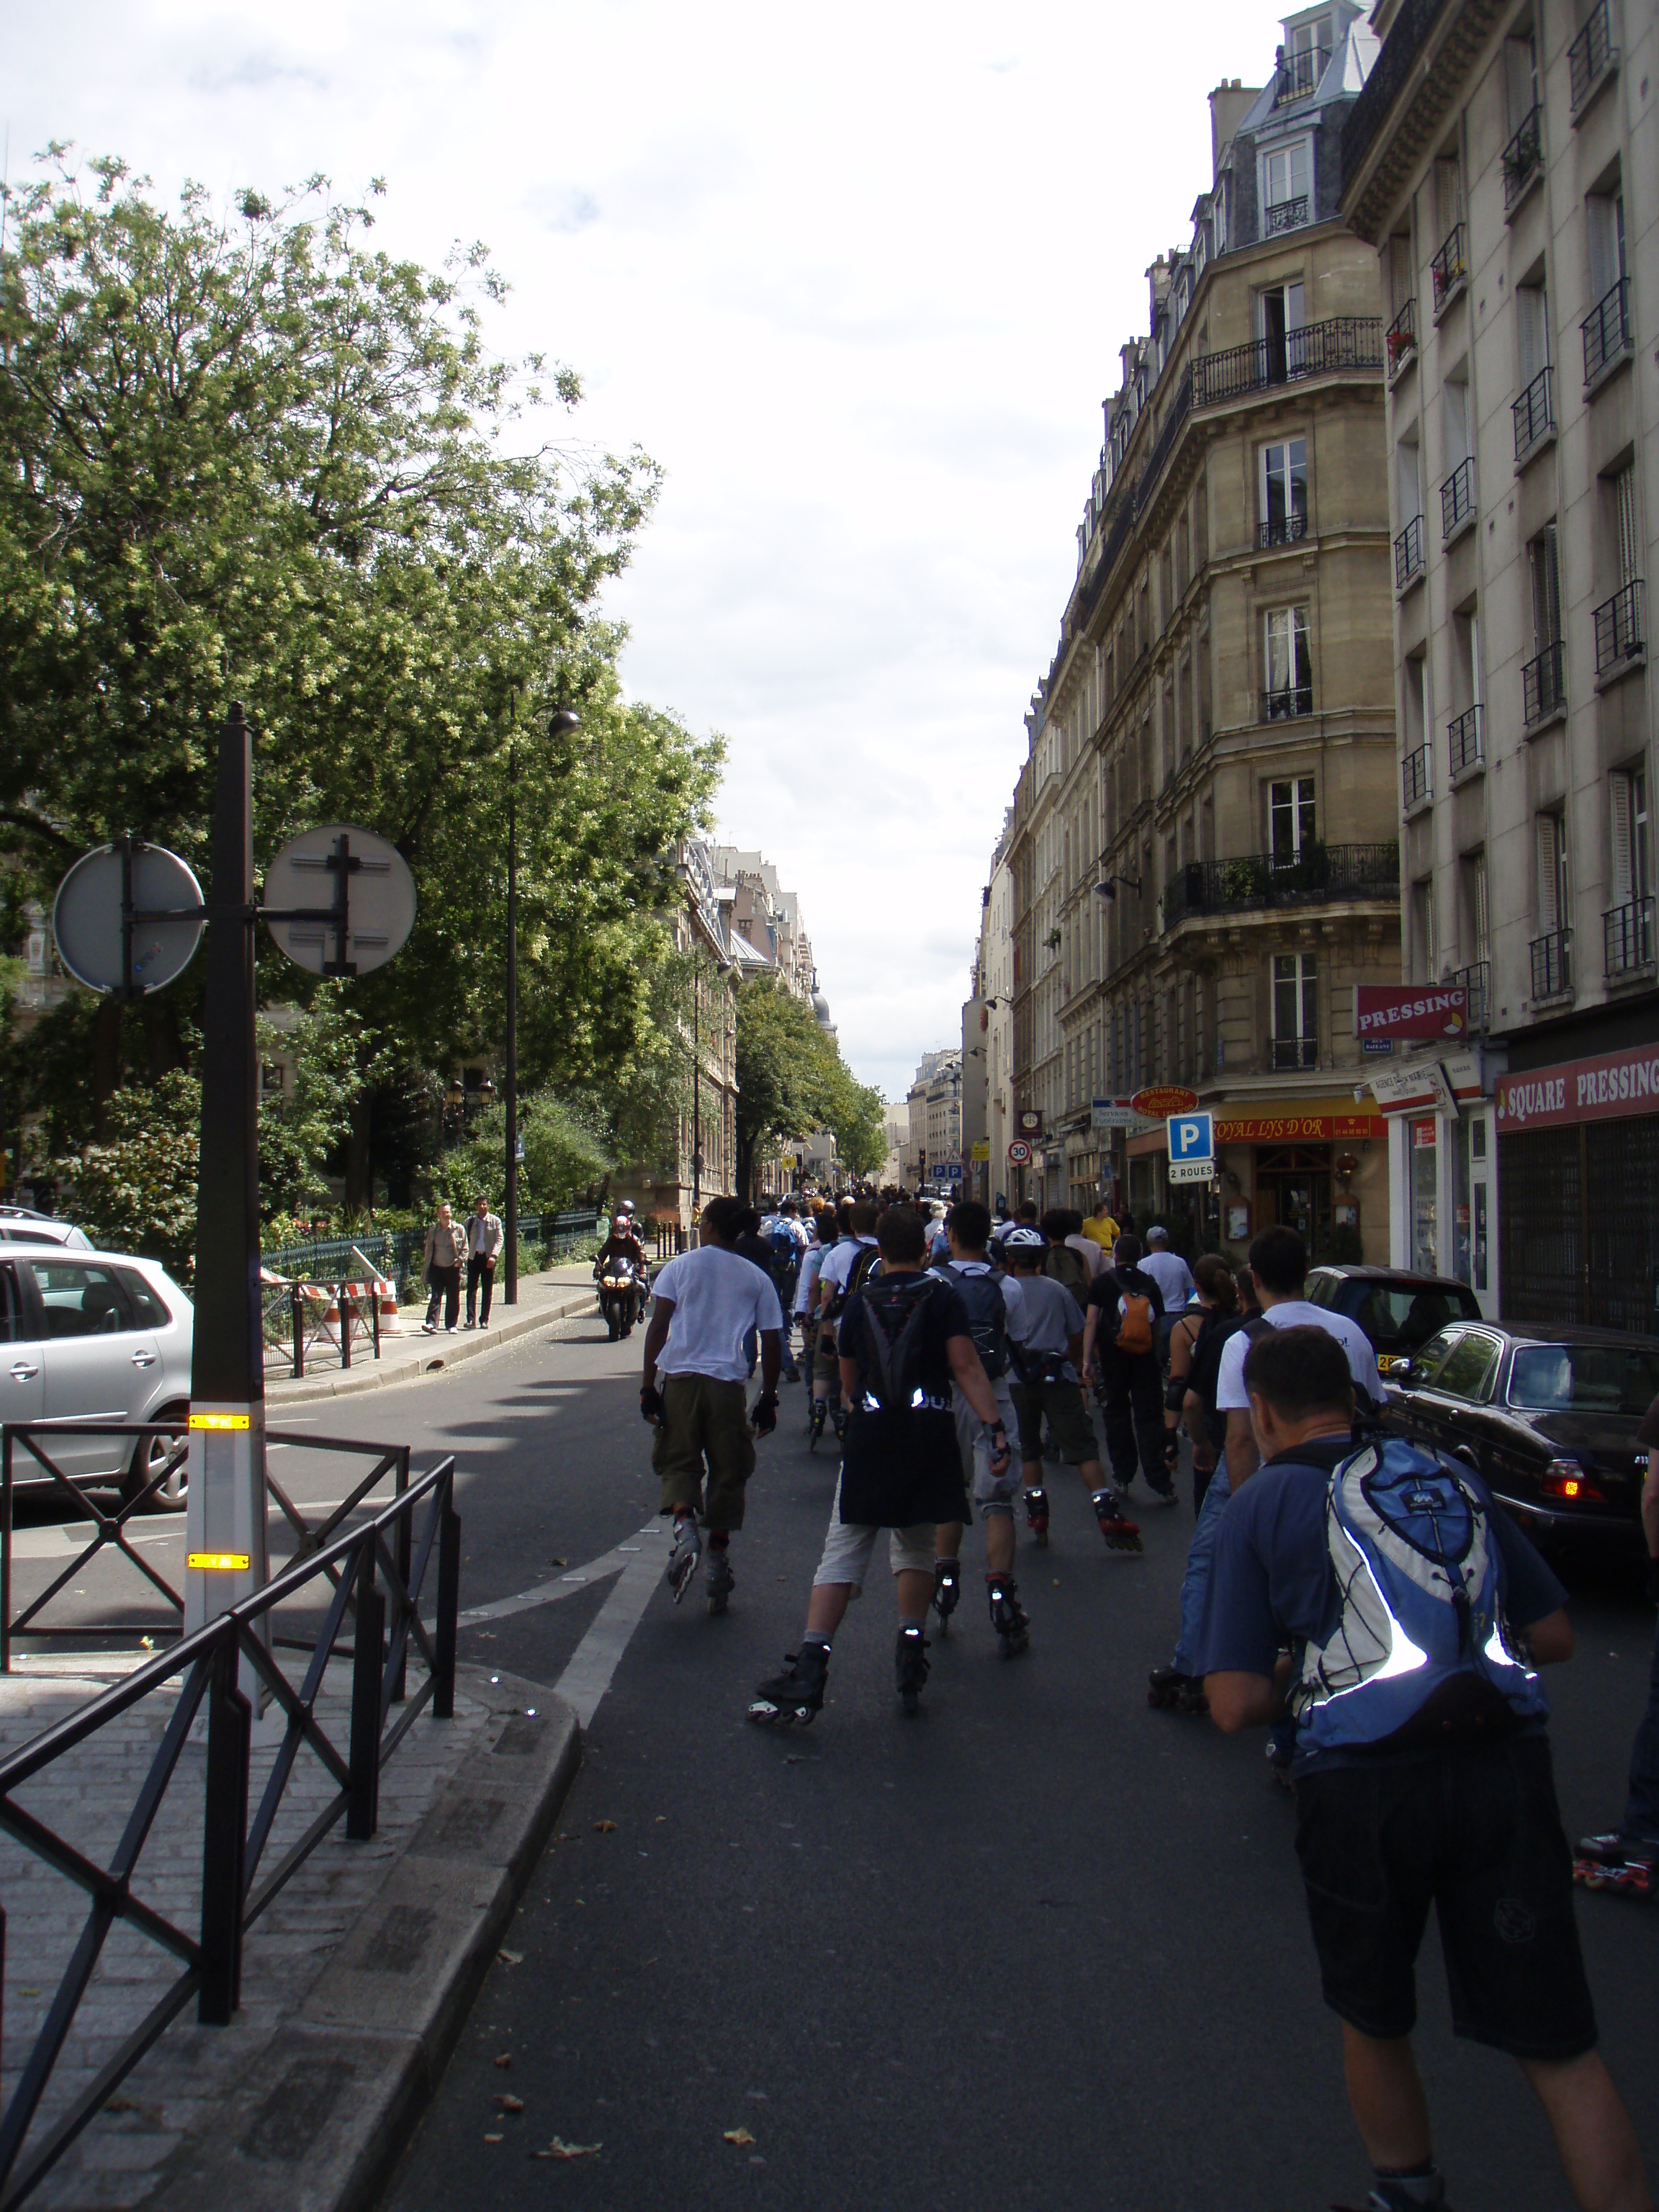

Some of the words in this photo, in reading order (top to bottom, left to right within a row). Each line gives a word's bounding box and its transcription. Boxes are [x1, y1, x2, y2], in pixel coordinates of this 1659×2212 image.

[1359, 991, 1465, 1030] PRESSING
[1140, 1087, 1190, 1100] RESTAURANT
[1508, 1078, 1565, 1122] SQUARE
[1577, 1058, 1659, 1107] PRESSING
[1138, 1106, 1159, 1117] ROYAL
[1257, 1119, 1284, 1139] LYS
[1287, 1118, 1325, 1138] D'OR
[1180, 1124, 1200, 1152] P
[1013, 1147, 1025, 1156] 30
[937, 1167, 942, 1176] P
[952, 1167, 958, 1176] P
[1171, 1169, 1177, 1178] 2
[1180, 1166, 1213, 1177] ROUES
